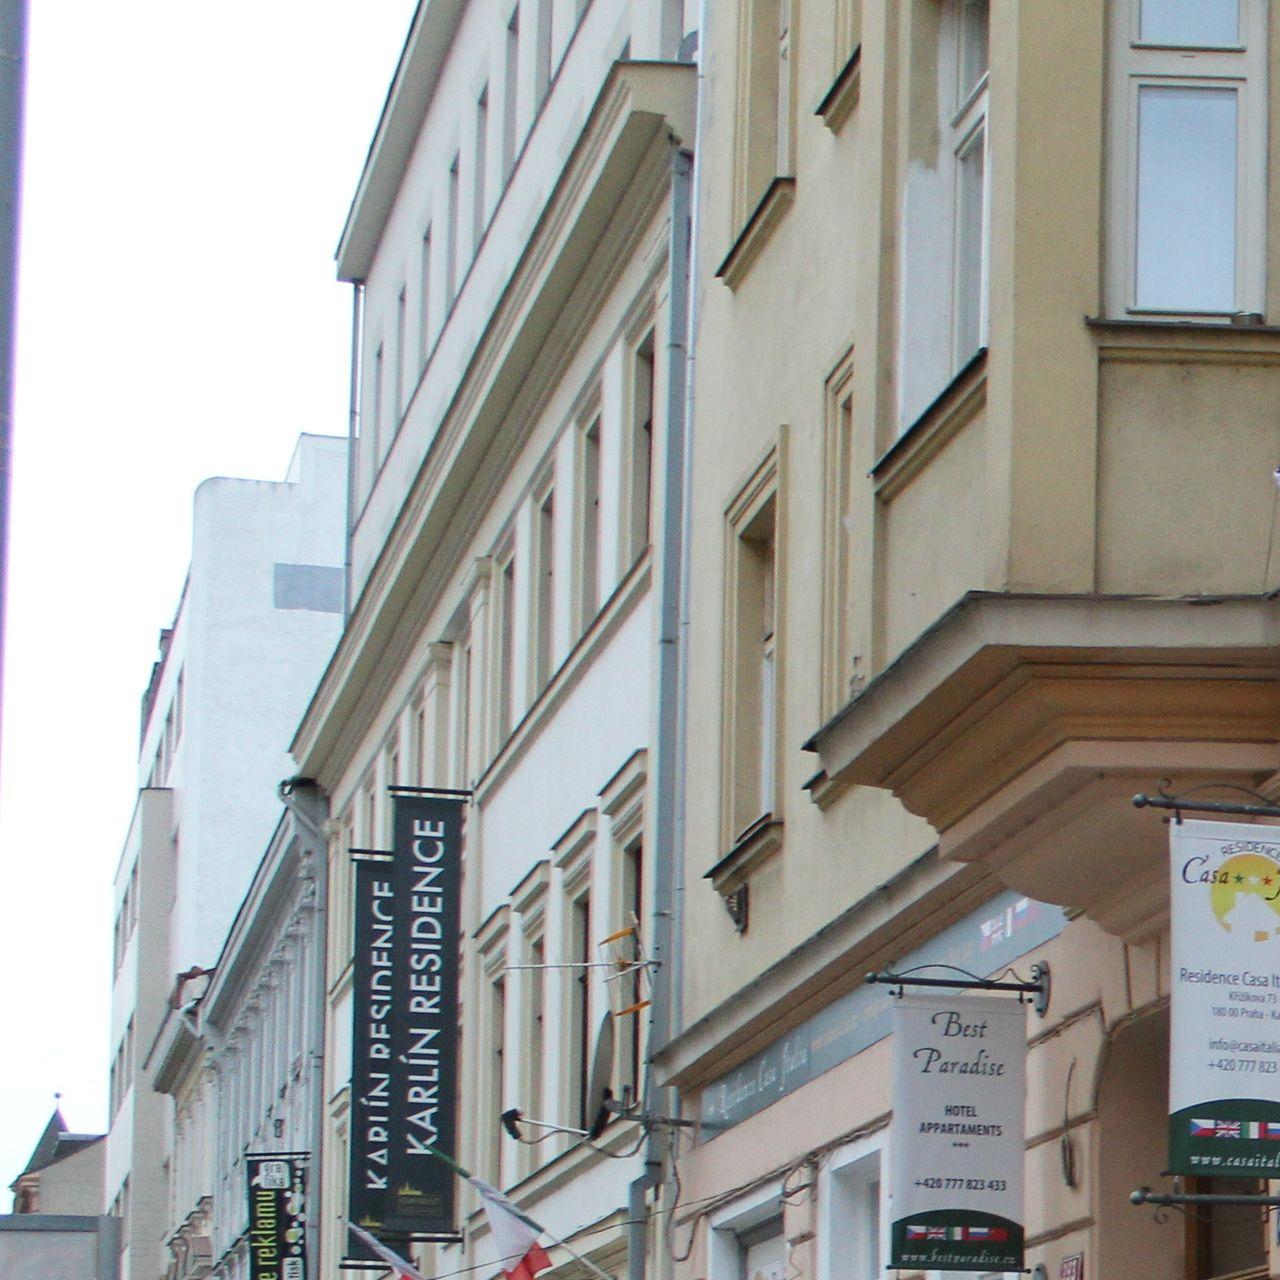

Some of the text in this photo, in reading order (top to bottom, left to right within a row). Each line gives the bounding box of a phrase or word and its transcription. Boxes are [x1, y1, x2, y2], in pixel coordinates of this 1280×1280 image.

[1181, 853, 1231, 884] Casa
[399, 818, 446, 1156] KARLÍN RESIDENCE
[1179, 967, 1240, 986] Residence
[1242, 971, 1269, 987] Casa
[930, 1010, 989, 1038] Best
[912, 1046, 1005, 1077] Paradise
[1207, 1058, 1236, 1072] +420
[1238, 1059, 1257, 1073] 777
[1258, 1060, 1278, 1074] 823
[944, 1104, 978, 1118] HOTEL
[919, 1122, 1003, 1137] APPARTAMENTS
[914, 1177, 1007, 1192] +420 777 823 433
[251, 1190, 278, 1266] reklamu
